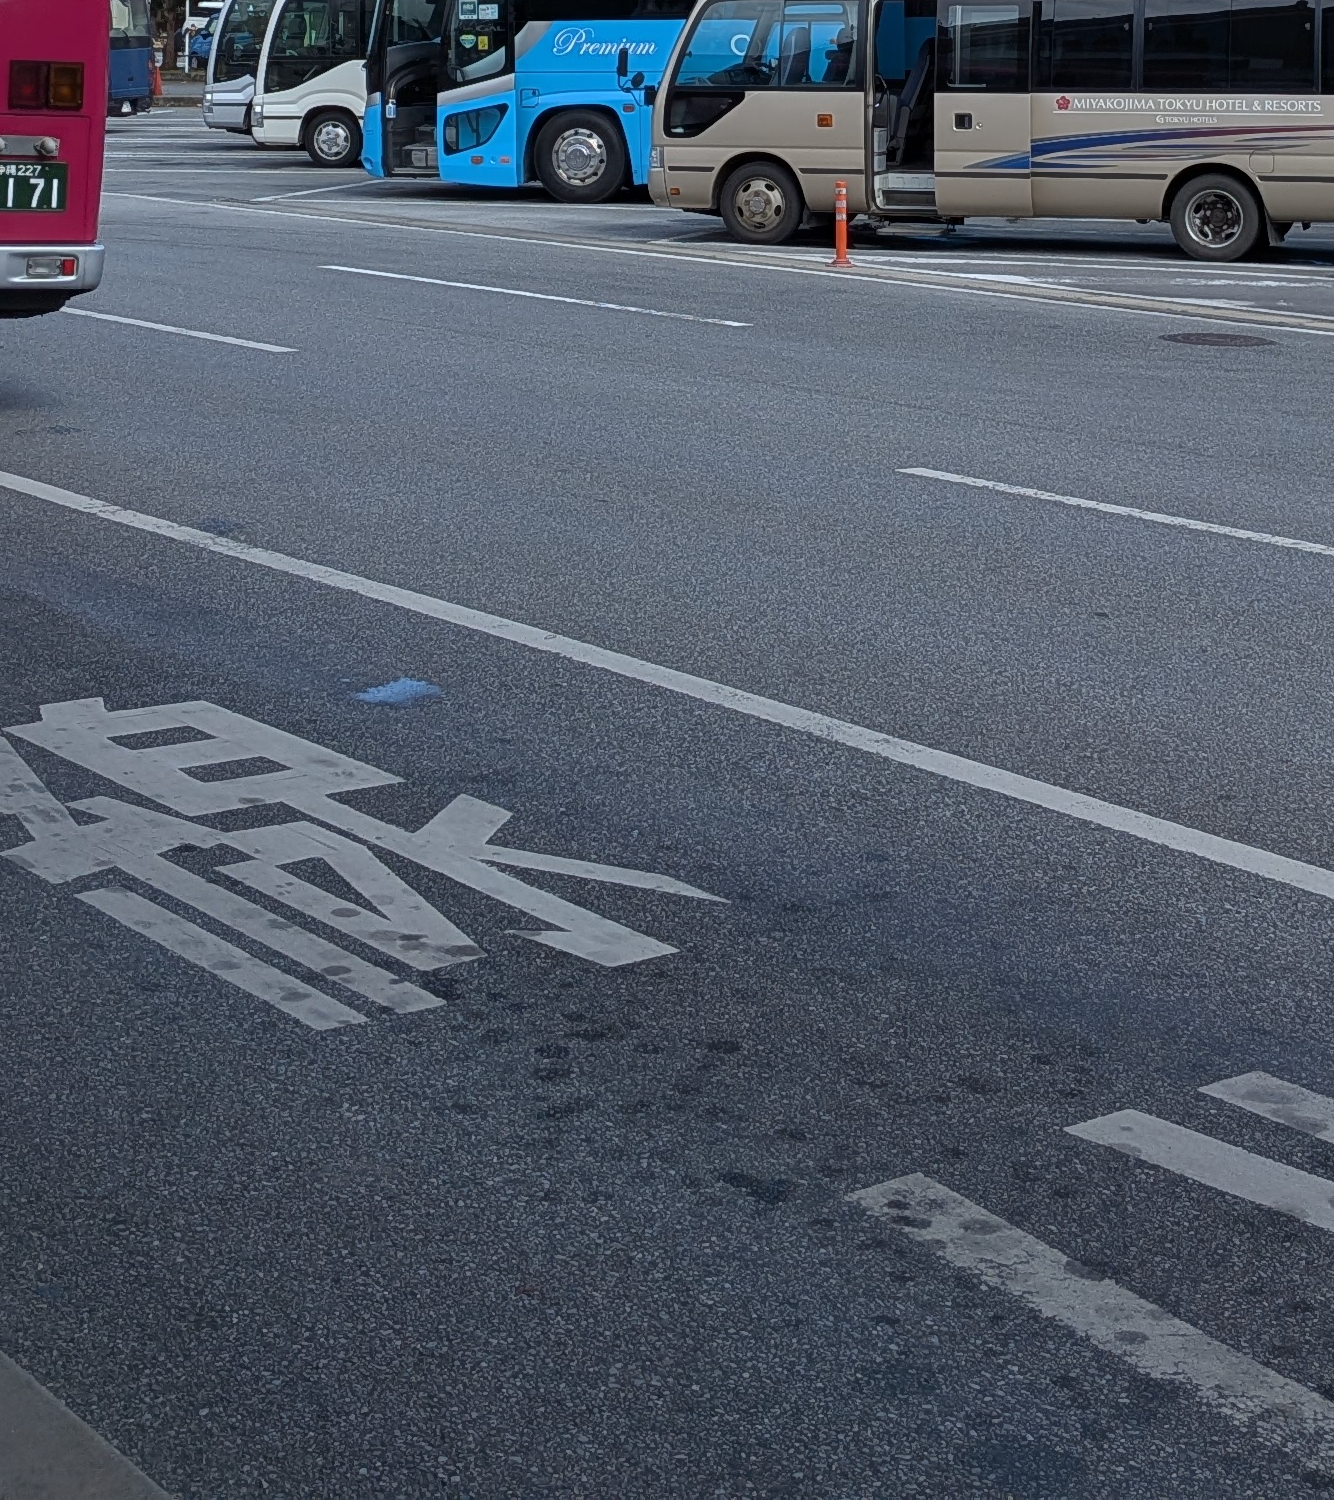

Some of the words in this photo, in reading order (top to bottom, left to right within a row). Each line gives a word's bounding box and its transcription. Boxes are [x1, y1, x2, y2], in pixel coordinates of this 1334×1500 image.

[552, 27, 658, 56] Premium
[1073, 98, 1155, 110] MIYAKOJIMA
[1157, 99, 1203, 111] TOKYU
[1206, 99, 1249, 111] HOTEL
[1252, 100, 1262, 111] &
[1264, 100, 1321, 112] RESORTS
[1191, 116, 1218, 124] HOTELS
